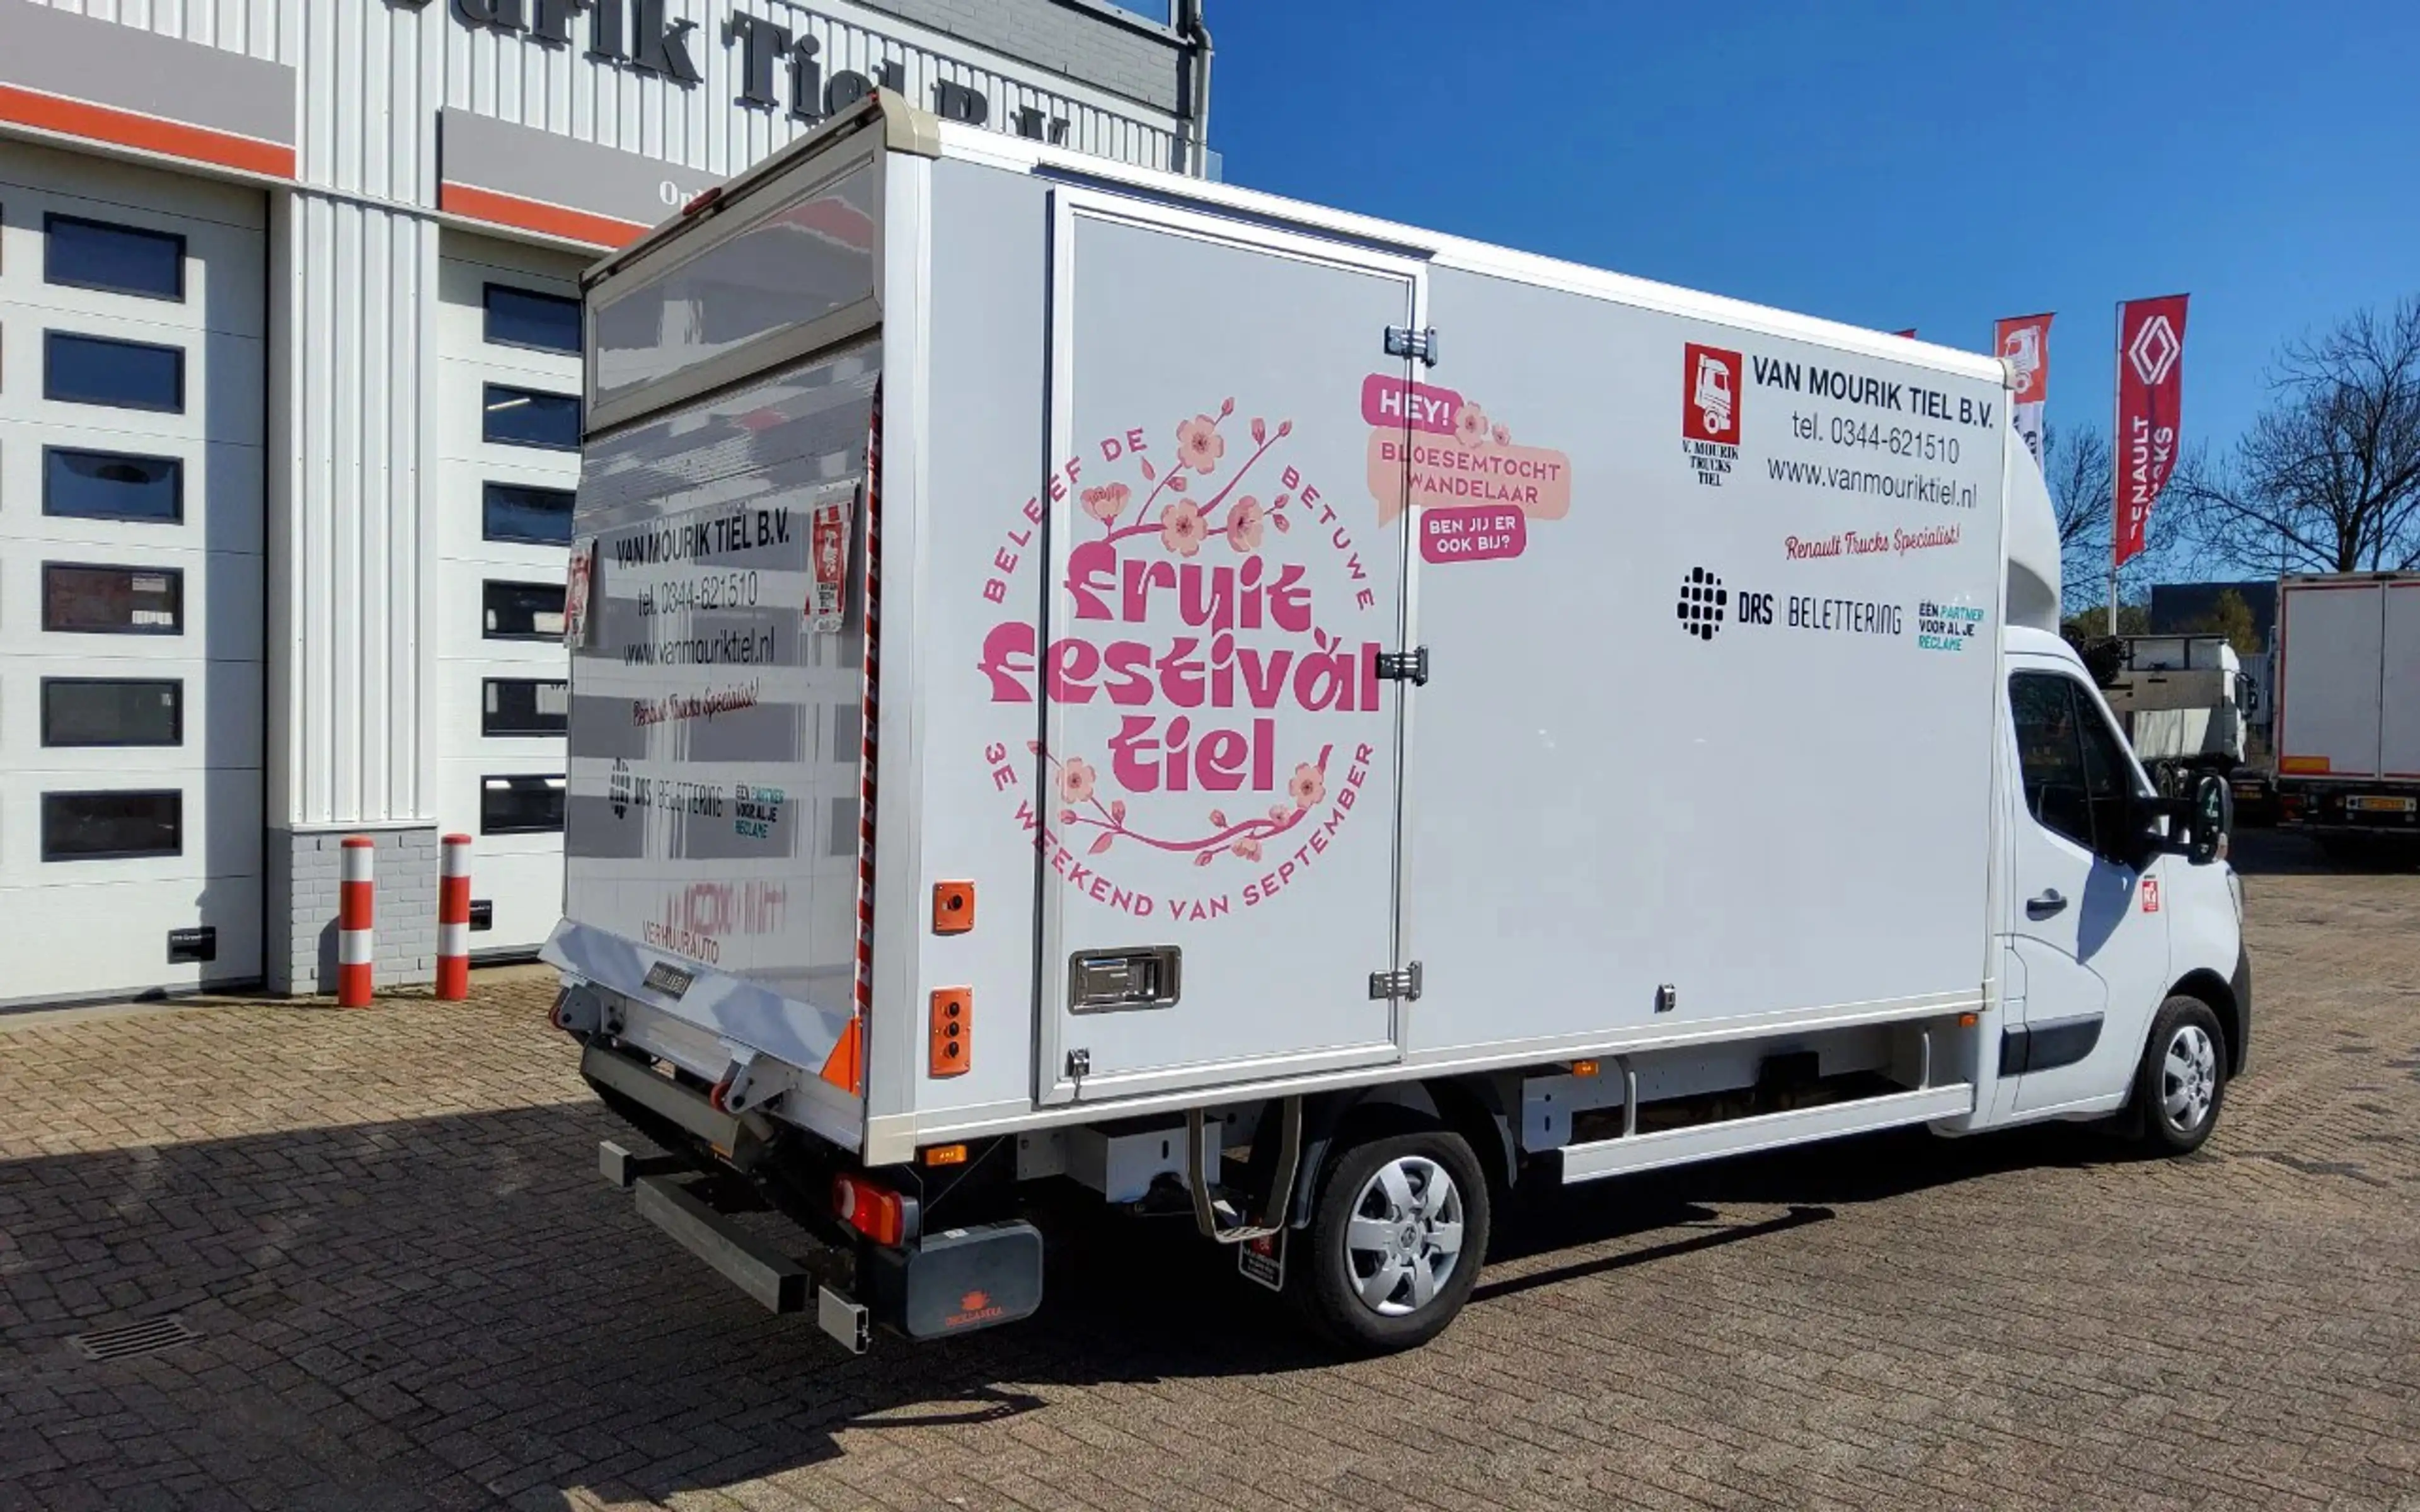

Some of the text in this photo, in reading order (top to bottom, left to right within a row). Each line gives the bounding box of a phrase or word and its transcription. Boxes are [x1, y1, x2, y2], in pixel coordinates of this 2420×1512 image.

[1380, 389, 1449, 427] HEY!
[1753, 355, 1994, 428] VAN MOURIK TIEL B.V.
[1683, 440, 1739, 460] V. MOURIK
[1792, 410, 1960, 464] tel. 0344-621510
[1381, 442, 1561, 481] BLOESEMTOCHT
[1690, 455, 1731, 473] TRUCKS
[1698, 471, 1722, 486] TIEL
[1407, 472, 1539, 504] WANDELAAR
[1767, 457, 1978, 509] www.vanmouriktiel.nl
[983, 427, 1376, 611] BELEEF DE BETUWE
[1429, 515, 1516, 535] BEN JIJ ER
[616, 507, 790, 570] VAN MOURIK TIEL B.V.
[1436, 534, 1511, 553] OOK BIJ?
[1785, 524, 1961, 560] Renault Trucks Specialist!
[638, 570, 758, 617] tel. 0344-621510
[1739, 591, 1902, 635] DRS BELETTERING
[1919, 619, 1974, 638] VOOR AL JE
[1940, 605, 1984, 621] PARTNER
[624, 626, 775, 667] www.vanmouriktiel.nl
[1919, 634, 1962, 651] RECLAME
[984, 742, 1374, 922] 3E WEEKEND VAN SEPTEMBER
[643, 919, 720, 965] VERHUURAUTO
